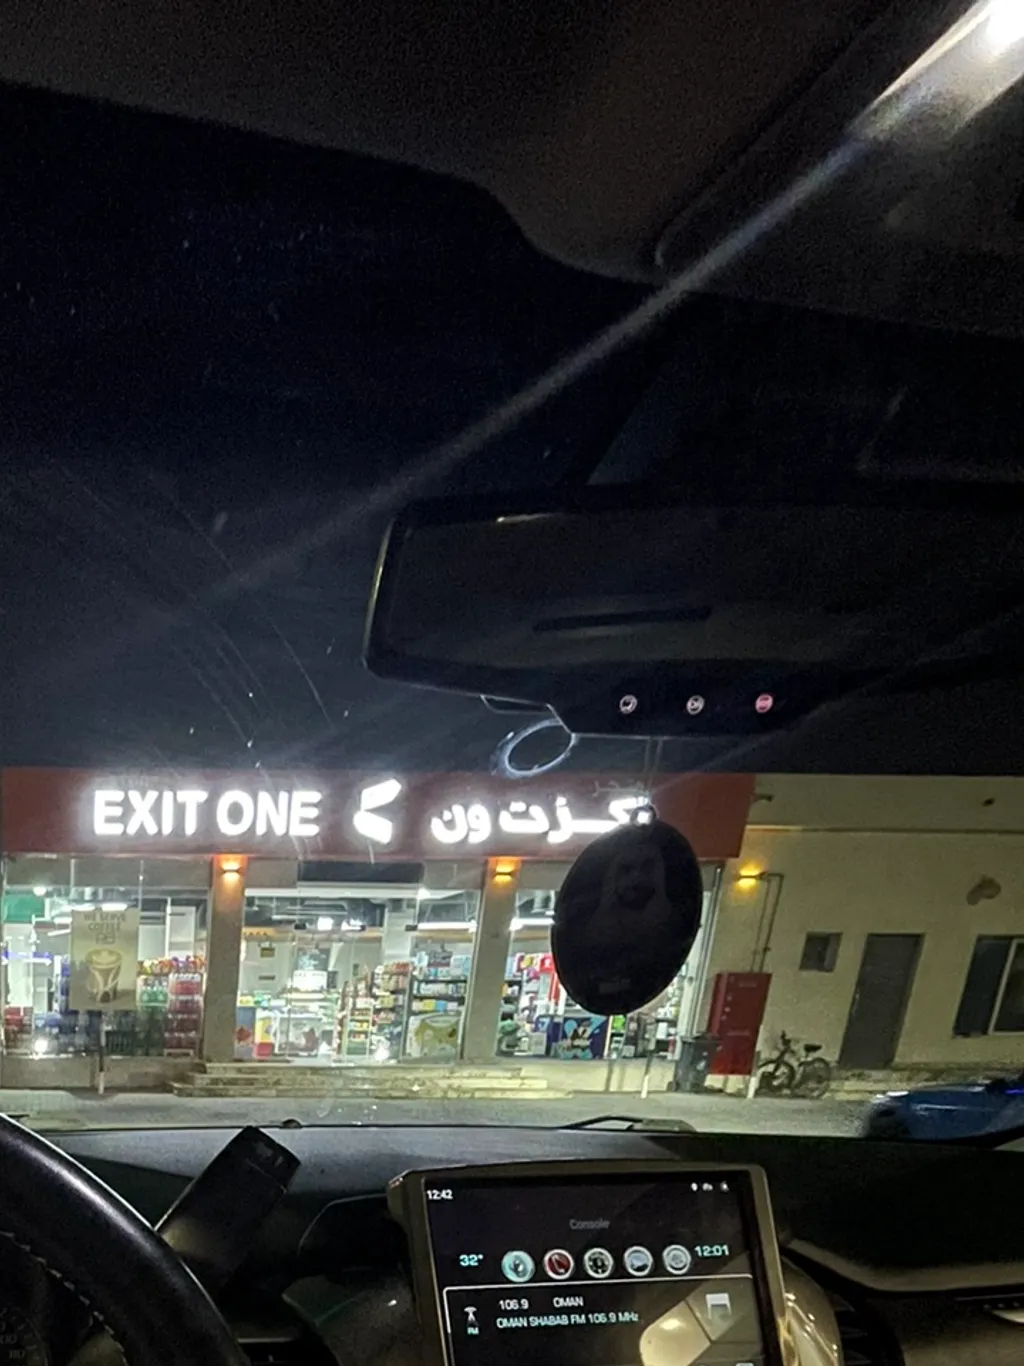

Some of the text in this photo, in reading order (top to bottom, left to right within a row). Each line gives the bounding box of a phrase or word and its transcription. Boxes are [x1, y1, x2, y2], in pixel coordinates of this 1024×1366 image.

[93, 790, 321, 837] EXIT ONE
[429, 801, 490, 844] ون
[426, 1189, 453, 1200] 12:42
[569, 1218, 610, 1230] Console
[694, 1245, 730, 1257] 12:01
[459, 1254, 484, 1267] 32°
[498, 1296, 584, 1311] 106.9 OMAN
[496, 1317, 527, 1329] OMAN
[529, 1315, 569, 1327] SHABAB
[570, 1313, 586, 1325] FM
